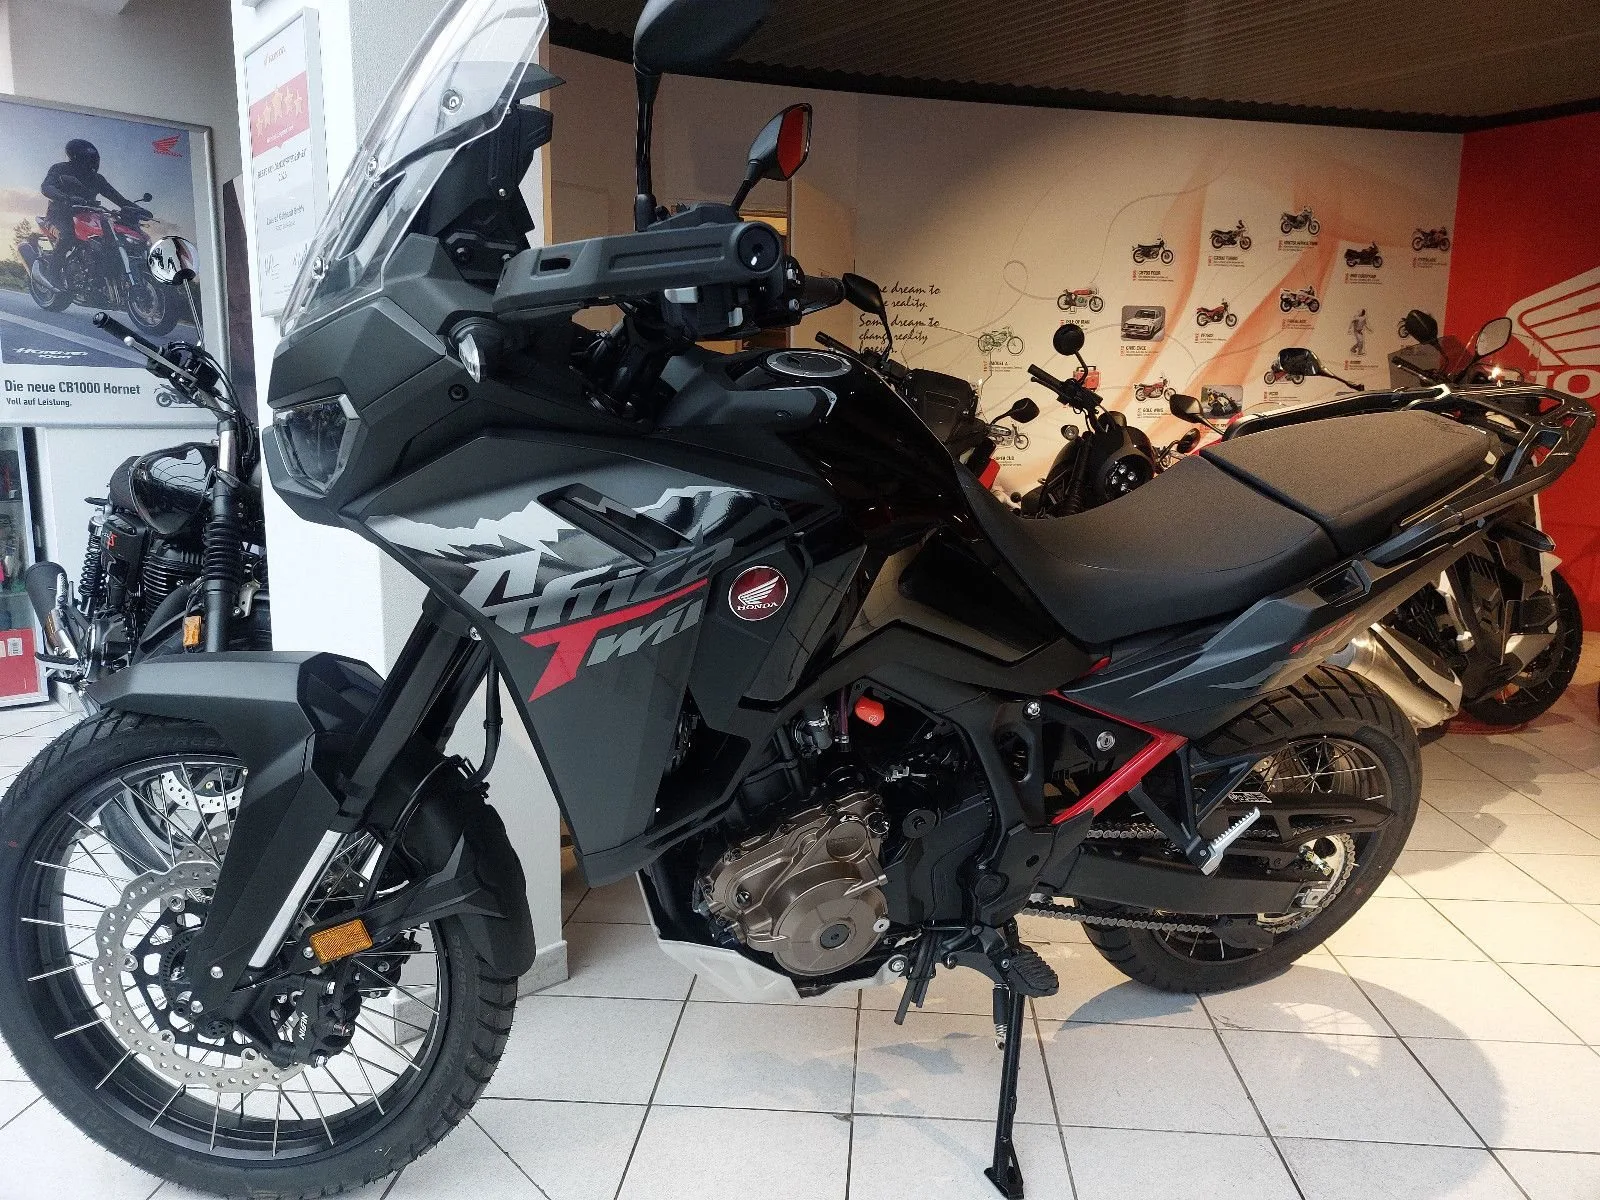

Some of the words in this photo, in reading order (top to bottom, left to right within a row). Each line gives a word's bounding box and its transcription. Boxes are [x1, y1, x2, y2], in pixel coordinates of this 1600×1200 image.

[891, 281, 926, 294] dream
[928, 284, 941, 295] to
[892, 296, 928, 312] reality.
[859, 313, 884, 327] Som
[891, 314, 926, 327] dream
[928, 317, 940, 327] to
[859, 329, 888, 345] chang
[894, 328, 928, 345] reality
[4, 380, 24, 392] Die
[27, 382, 56, 393] neue
[59, 381, 101, 394] CB1000
[103, 382, 141, 395] Hornet
[24, 398, 36, 406] auf
[38, 398, 72, 408] Leistung.
[737, 601, 779, 611] HONDA
